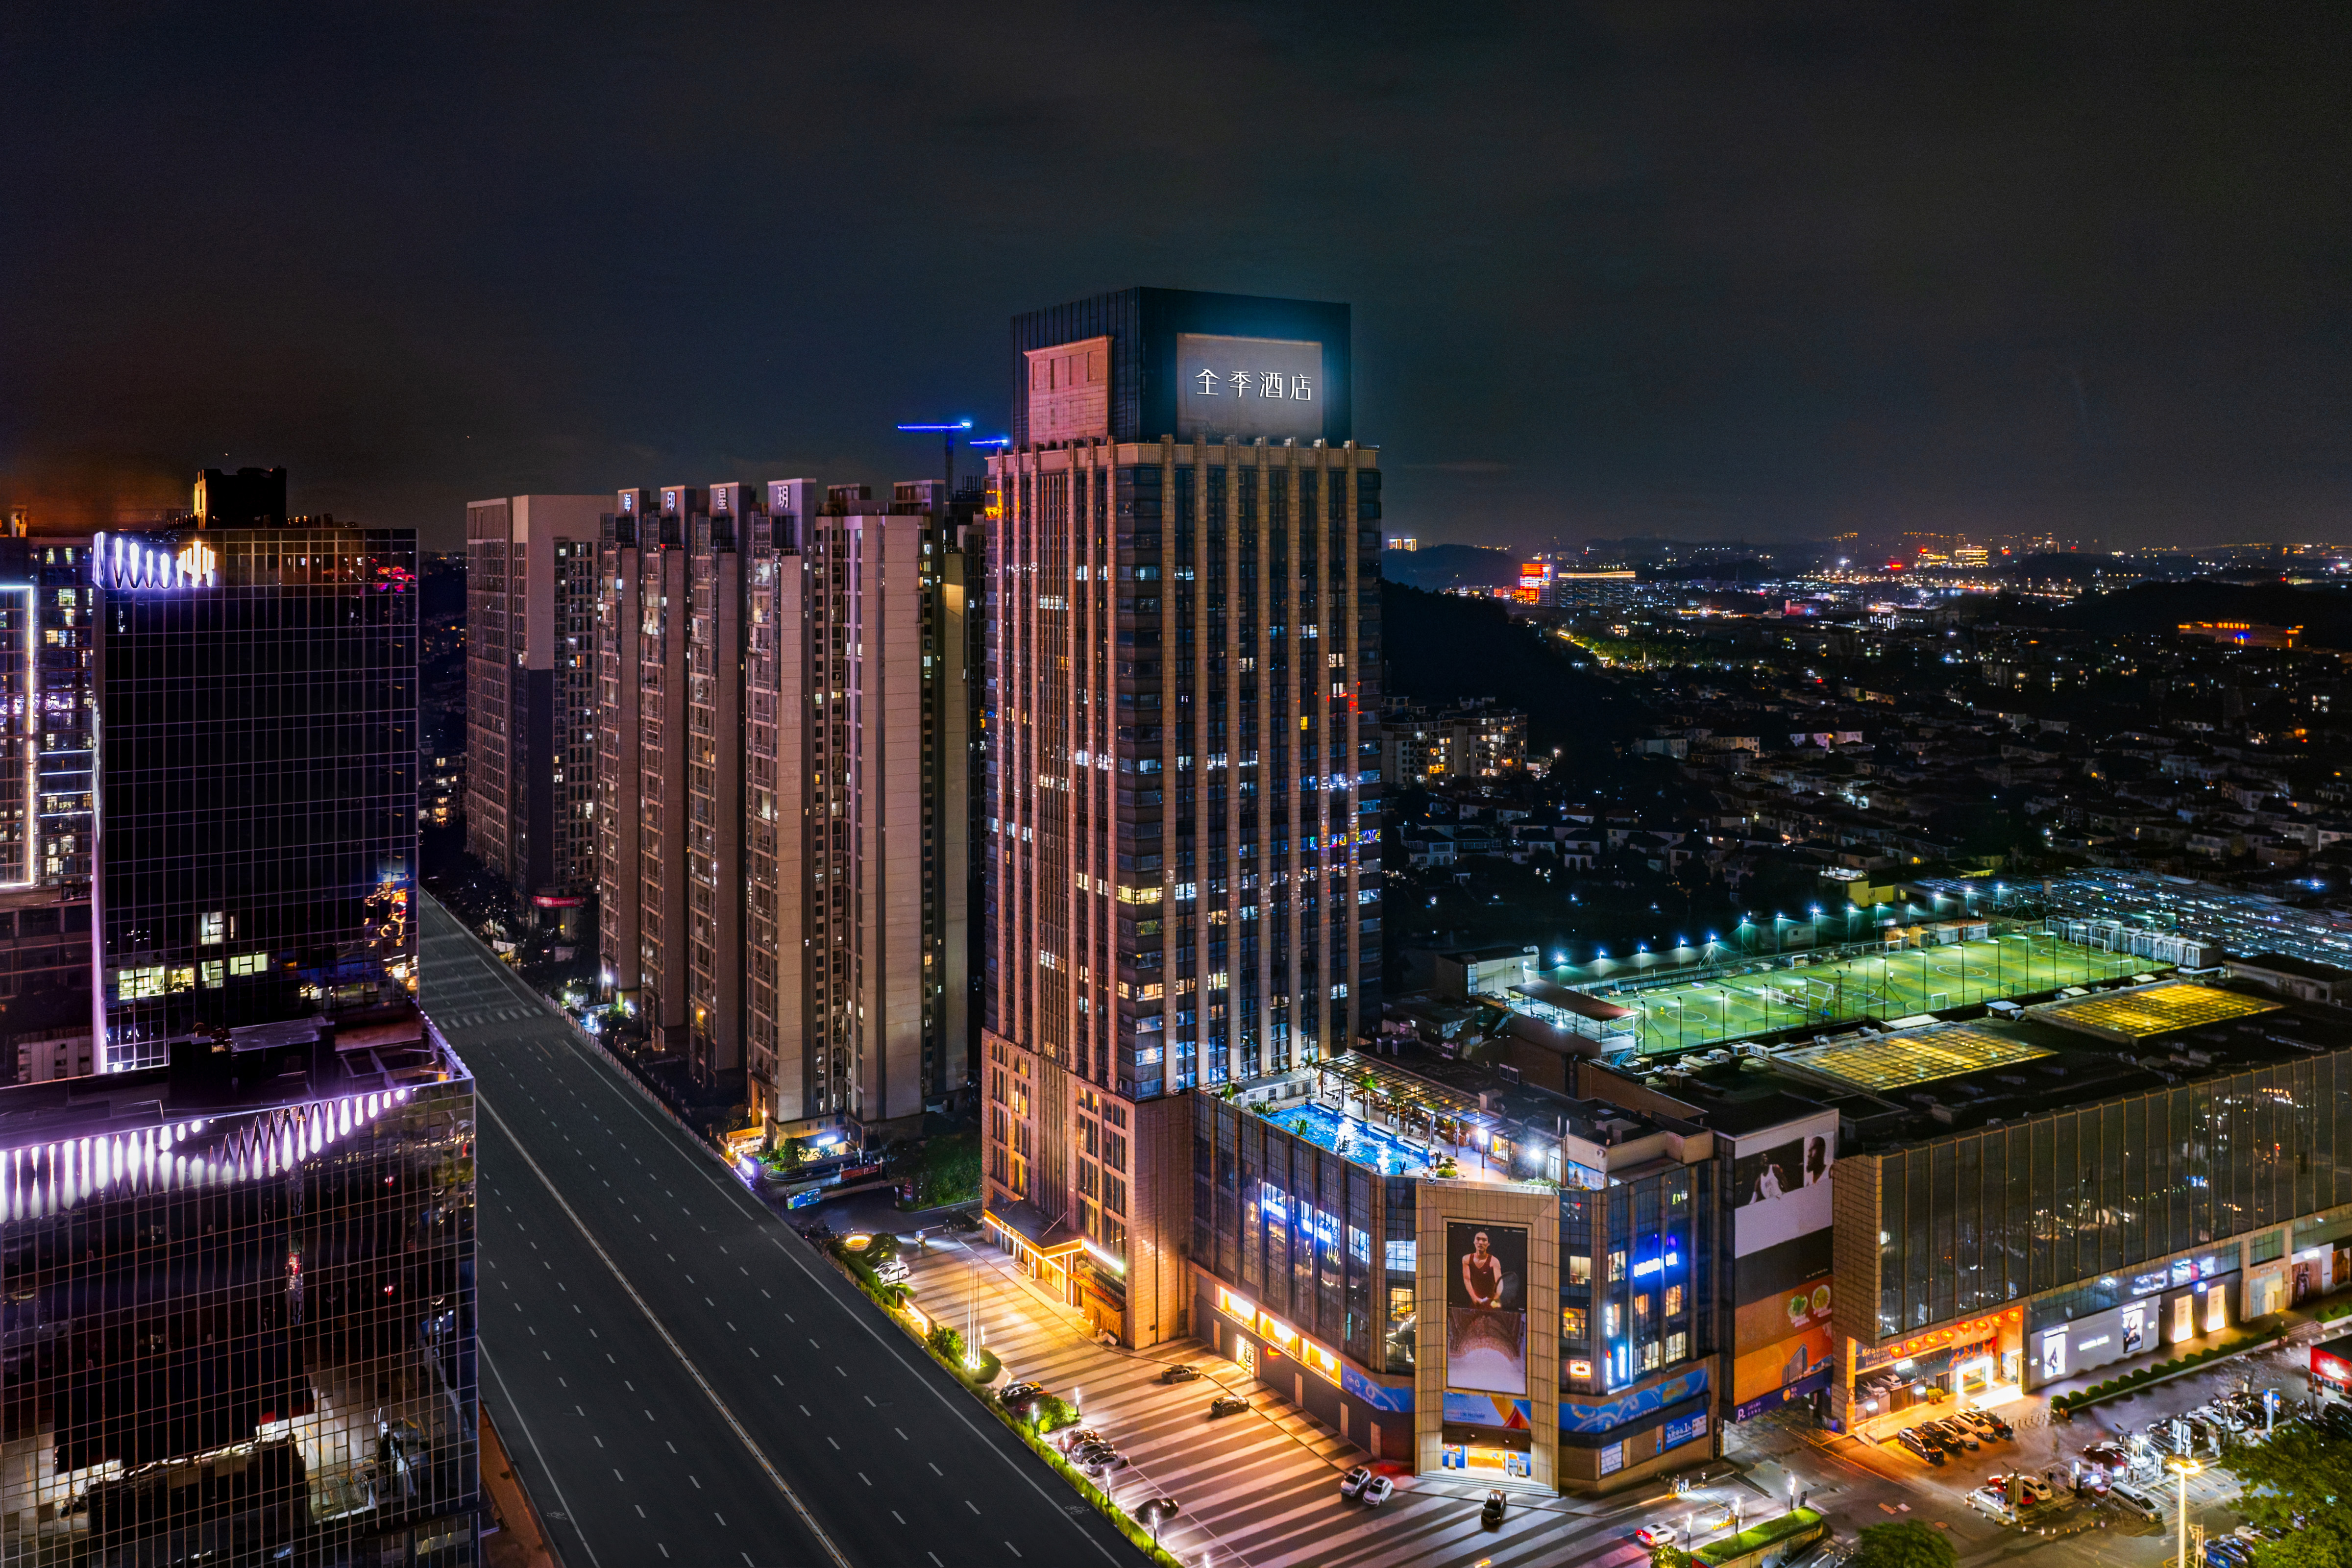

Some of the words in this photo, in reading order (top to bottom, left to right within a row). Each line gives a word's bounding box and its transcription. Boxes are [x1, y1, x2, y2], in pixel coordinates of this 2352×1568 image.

[1195, 368, 1312, 401] 全季酒店
[999, 1220, 1025, 1250] 全季酒店
